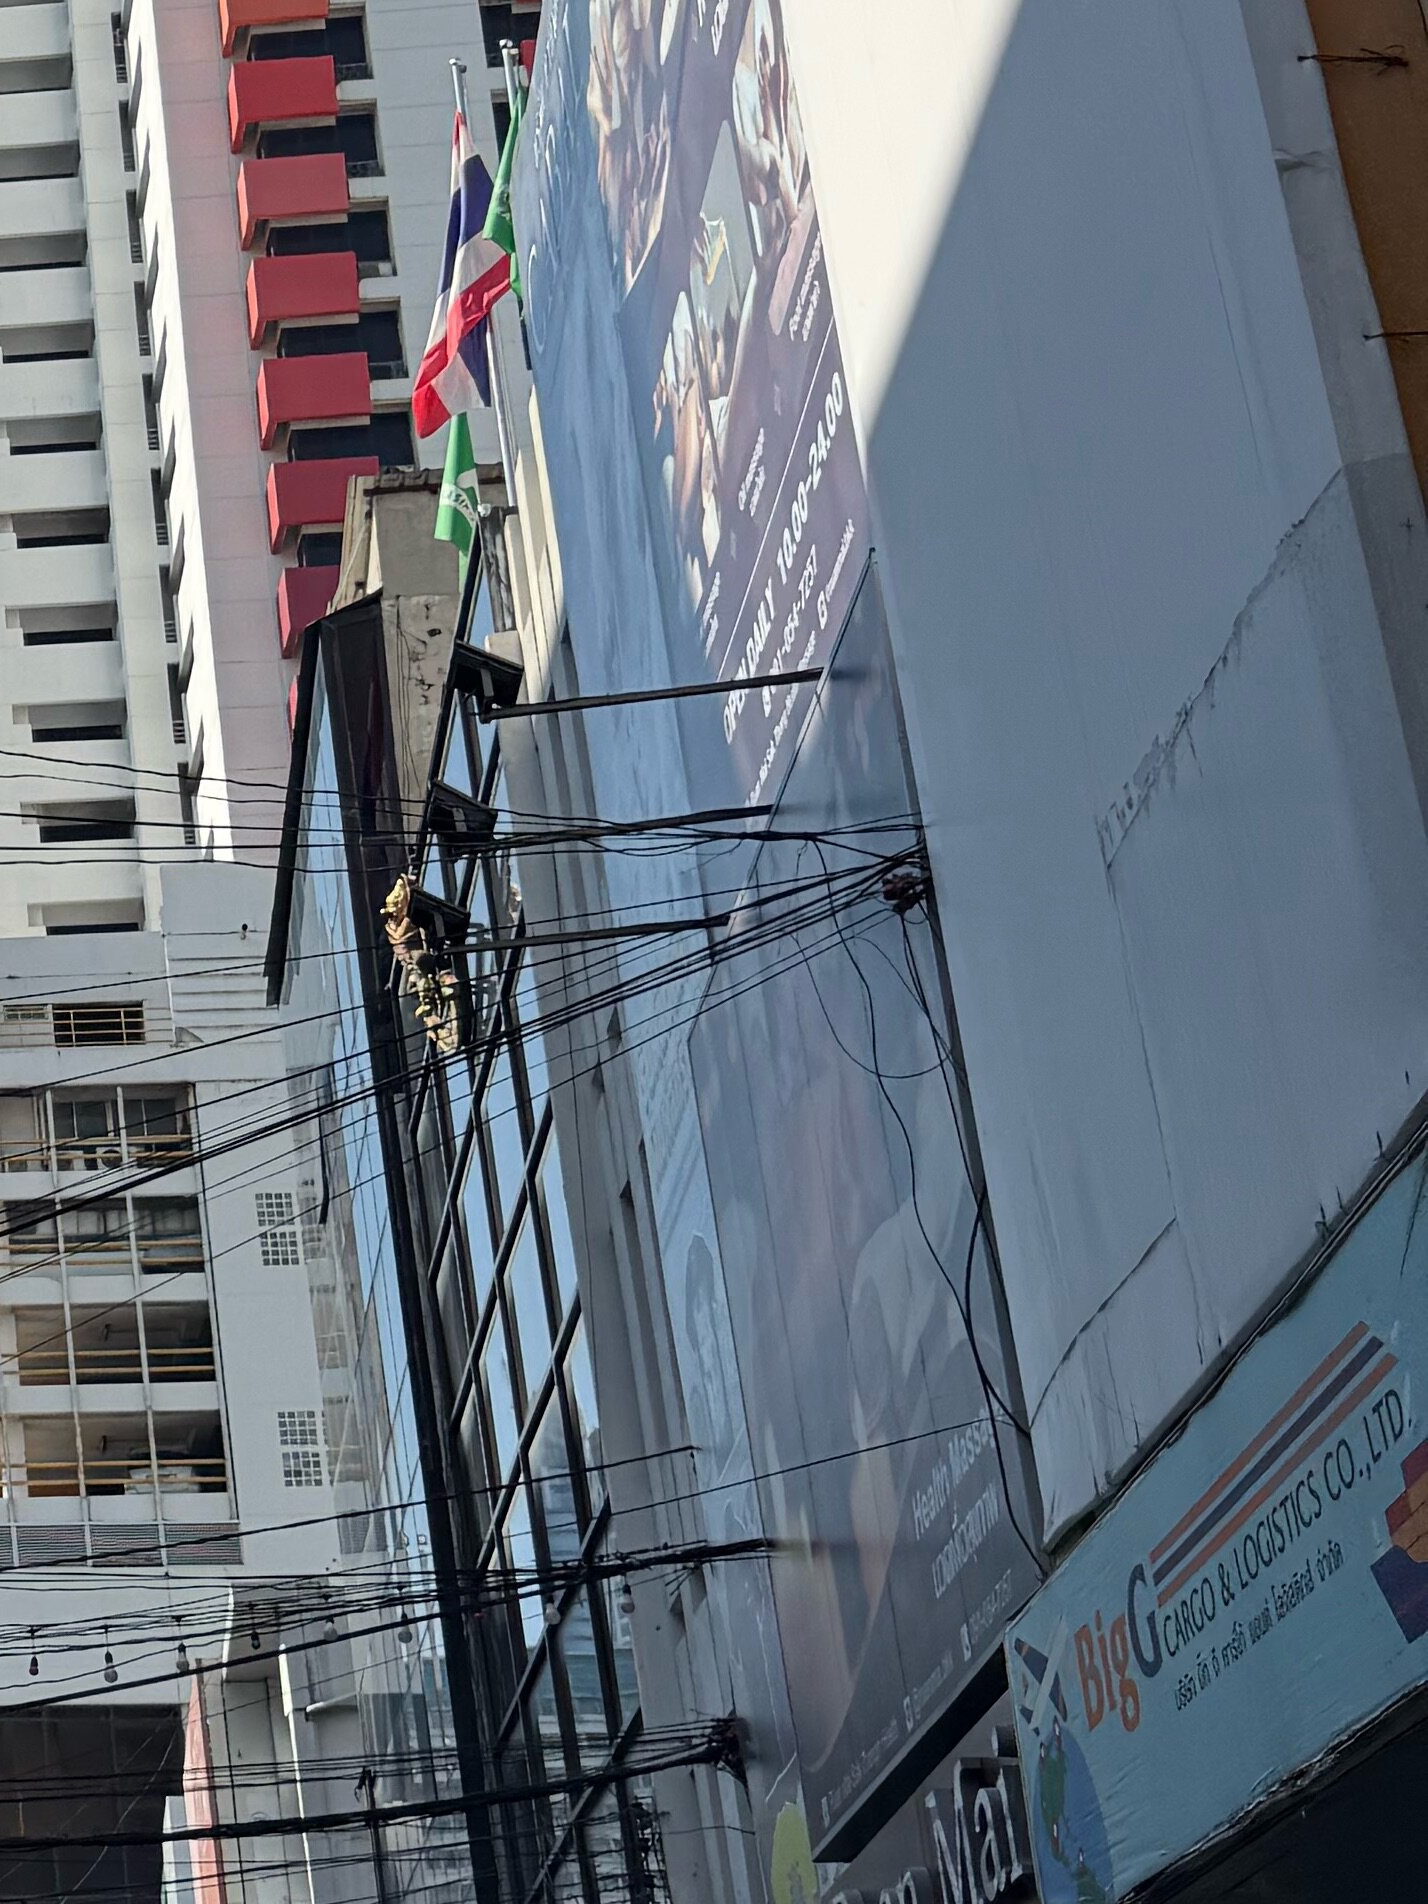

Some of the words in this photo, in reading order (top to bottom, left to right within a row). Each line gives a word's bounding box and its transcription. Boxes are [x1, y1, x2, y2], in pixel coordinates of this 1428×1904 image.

[744, 574, 778, 680] DAILY
[775, 371, 844, 586] 10.00-24.00
[912, 1458, 951, 1541] Health
[1163, 1577, 1216, 1657] CARGO
[1218, 1563, 1235, 1607] &
[1233, 1472, 1323, 1590] LOGISTICS
